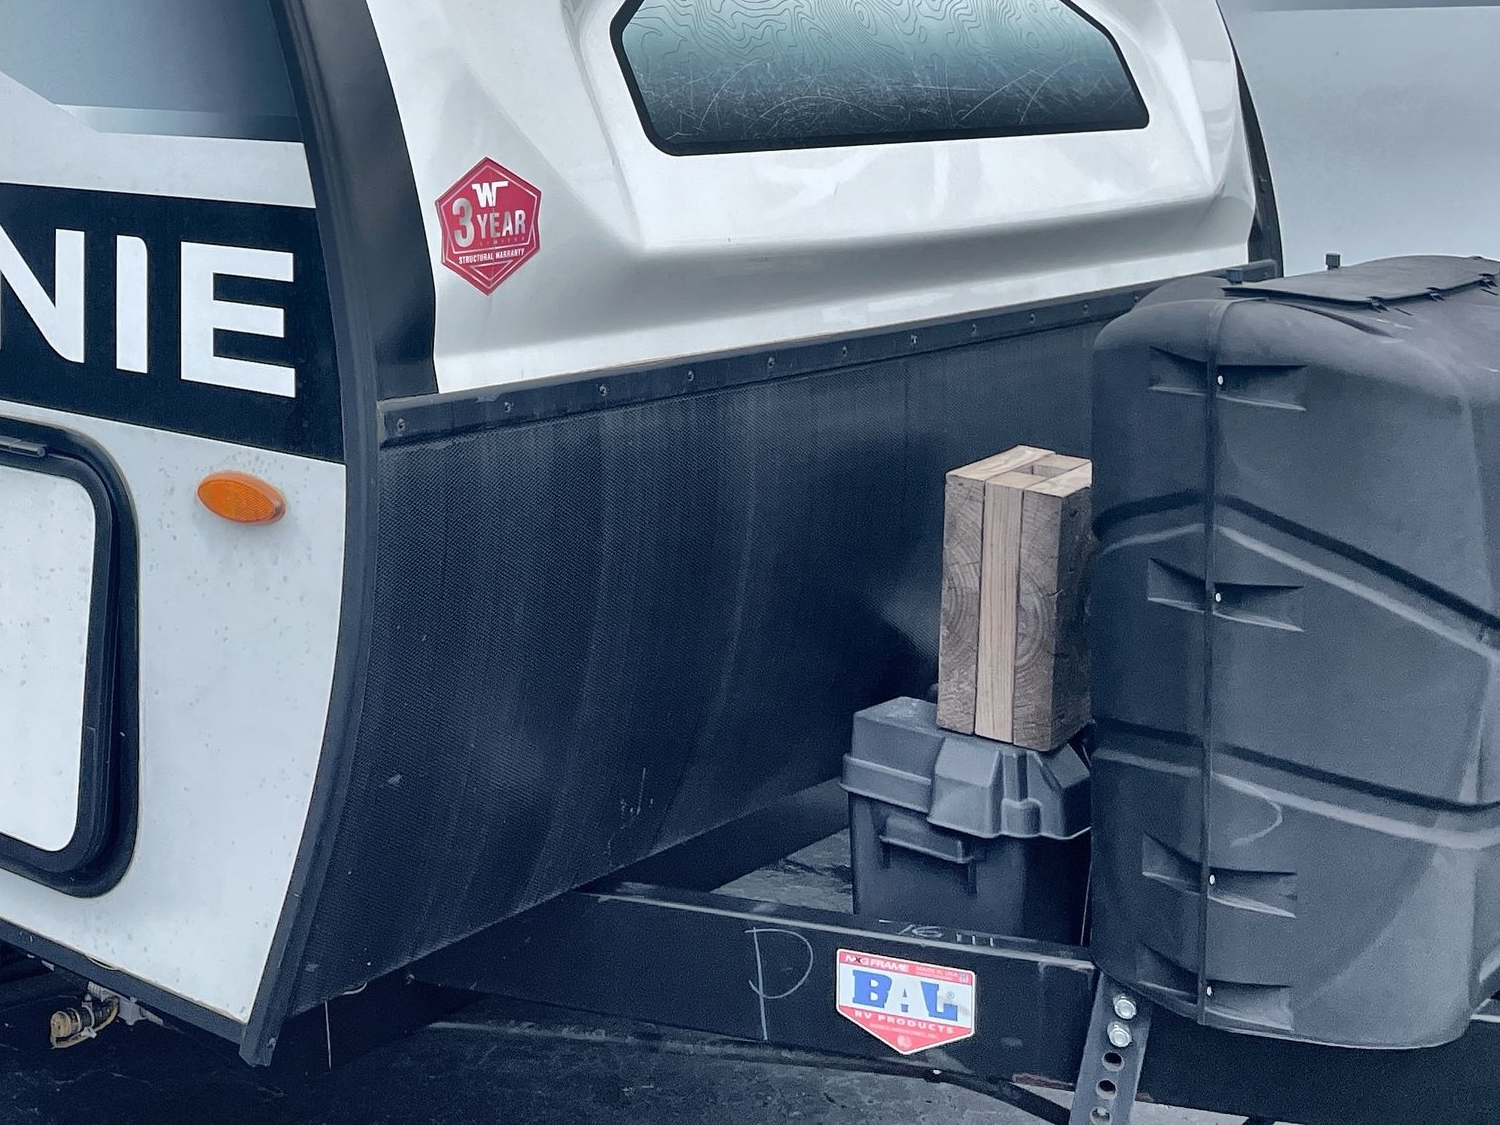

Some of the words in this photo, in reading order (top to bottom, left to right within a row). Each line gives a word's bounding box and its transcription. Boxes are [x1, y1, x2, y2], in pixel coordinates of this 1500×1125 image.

[452, 197, 475, 248] 3
[477, 210, 526, 239] YEAR
[458, 252, 494, 265] STRUCTURAL
[495, 248, 525, 260] WARRANTY
[870, 957, 909, 973] FRAME
[852, 969, 958, 1021] BAL
[854, 1010, 873, 1021] RV
[877, 1014, 955, 1035] PRODUCTS
